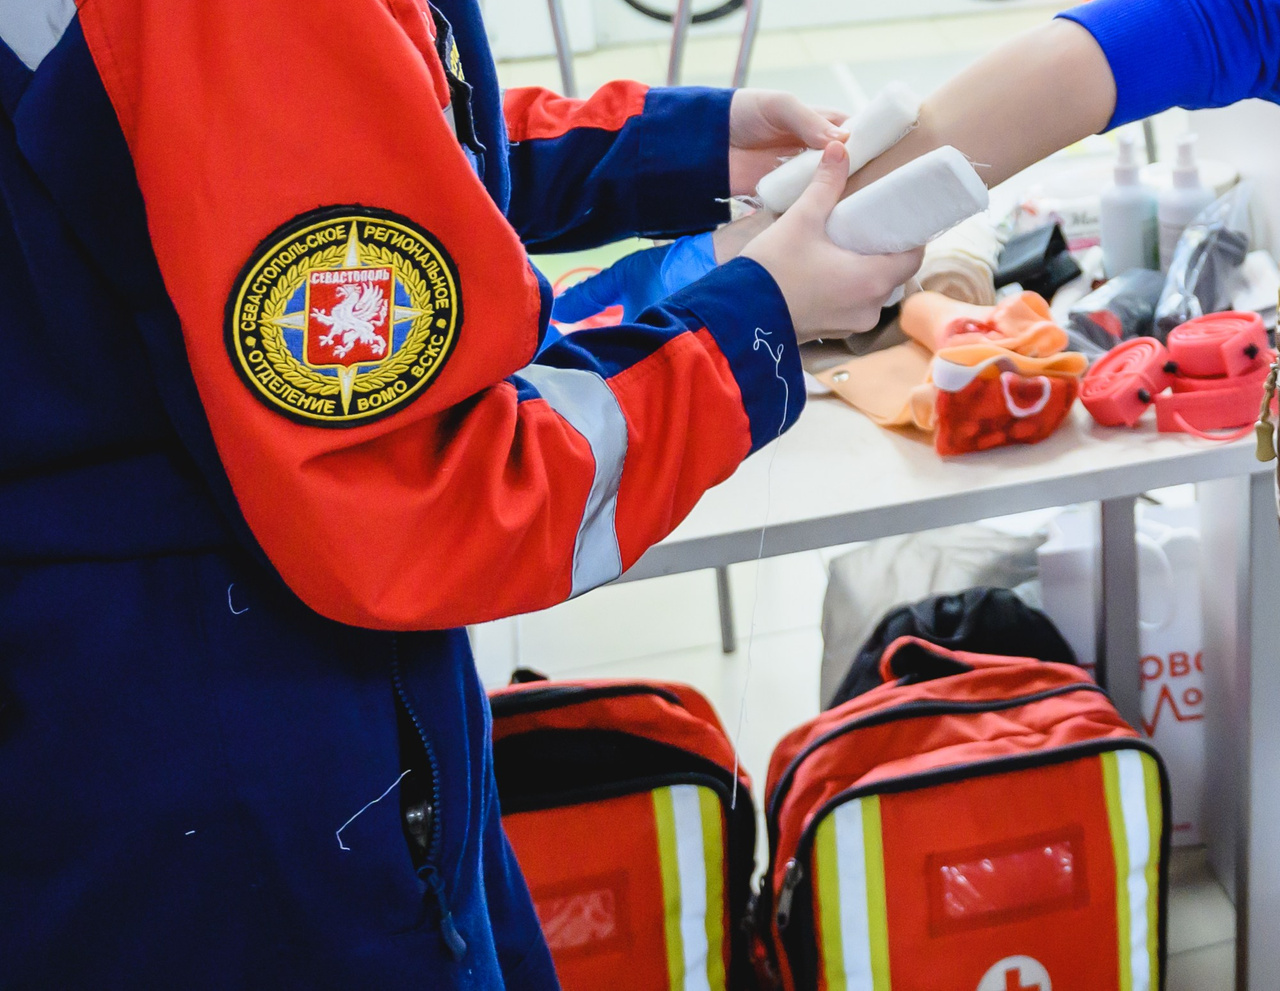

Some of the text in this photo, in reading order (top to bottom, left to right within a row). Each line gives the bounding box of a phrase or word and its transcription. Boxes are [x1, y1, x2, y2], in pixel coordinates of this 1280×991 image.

[241, 224, 449, 331] СЕВАСТОПОЛЬСКОЕ РЕГИОНАЛЬНОЕ
[310, 269, 390, 284] СЕВАСТОПОЛЬ
[249, 334, 444, 414] ОТДЕЛЕНИЕ ВОМО ВСКС
